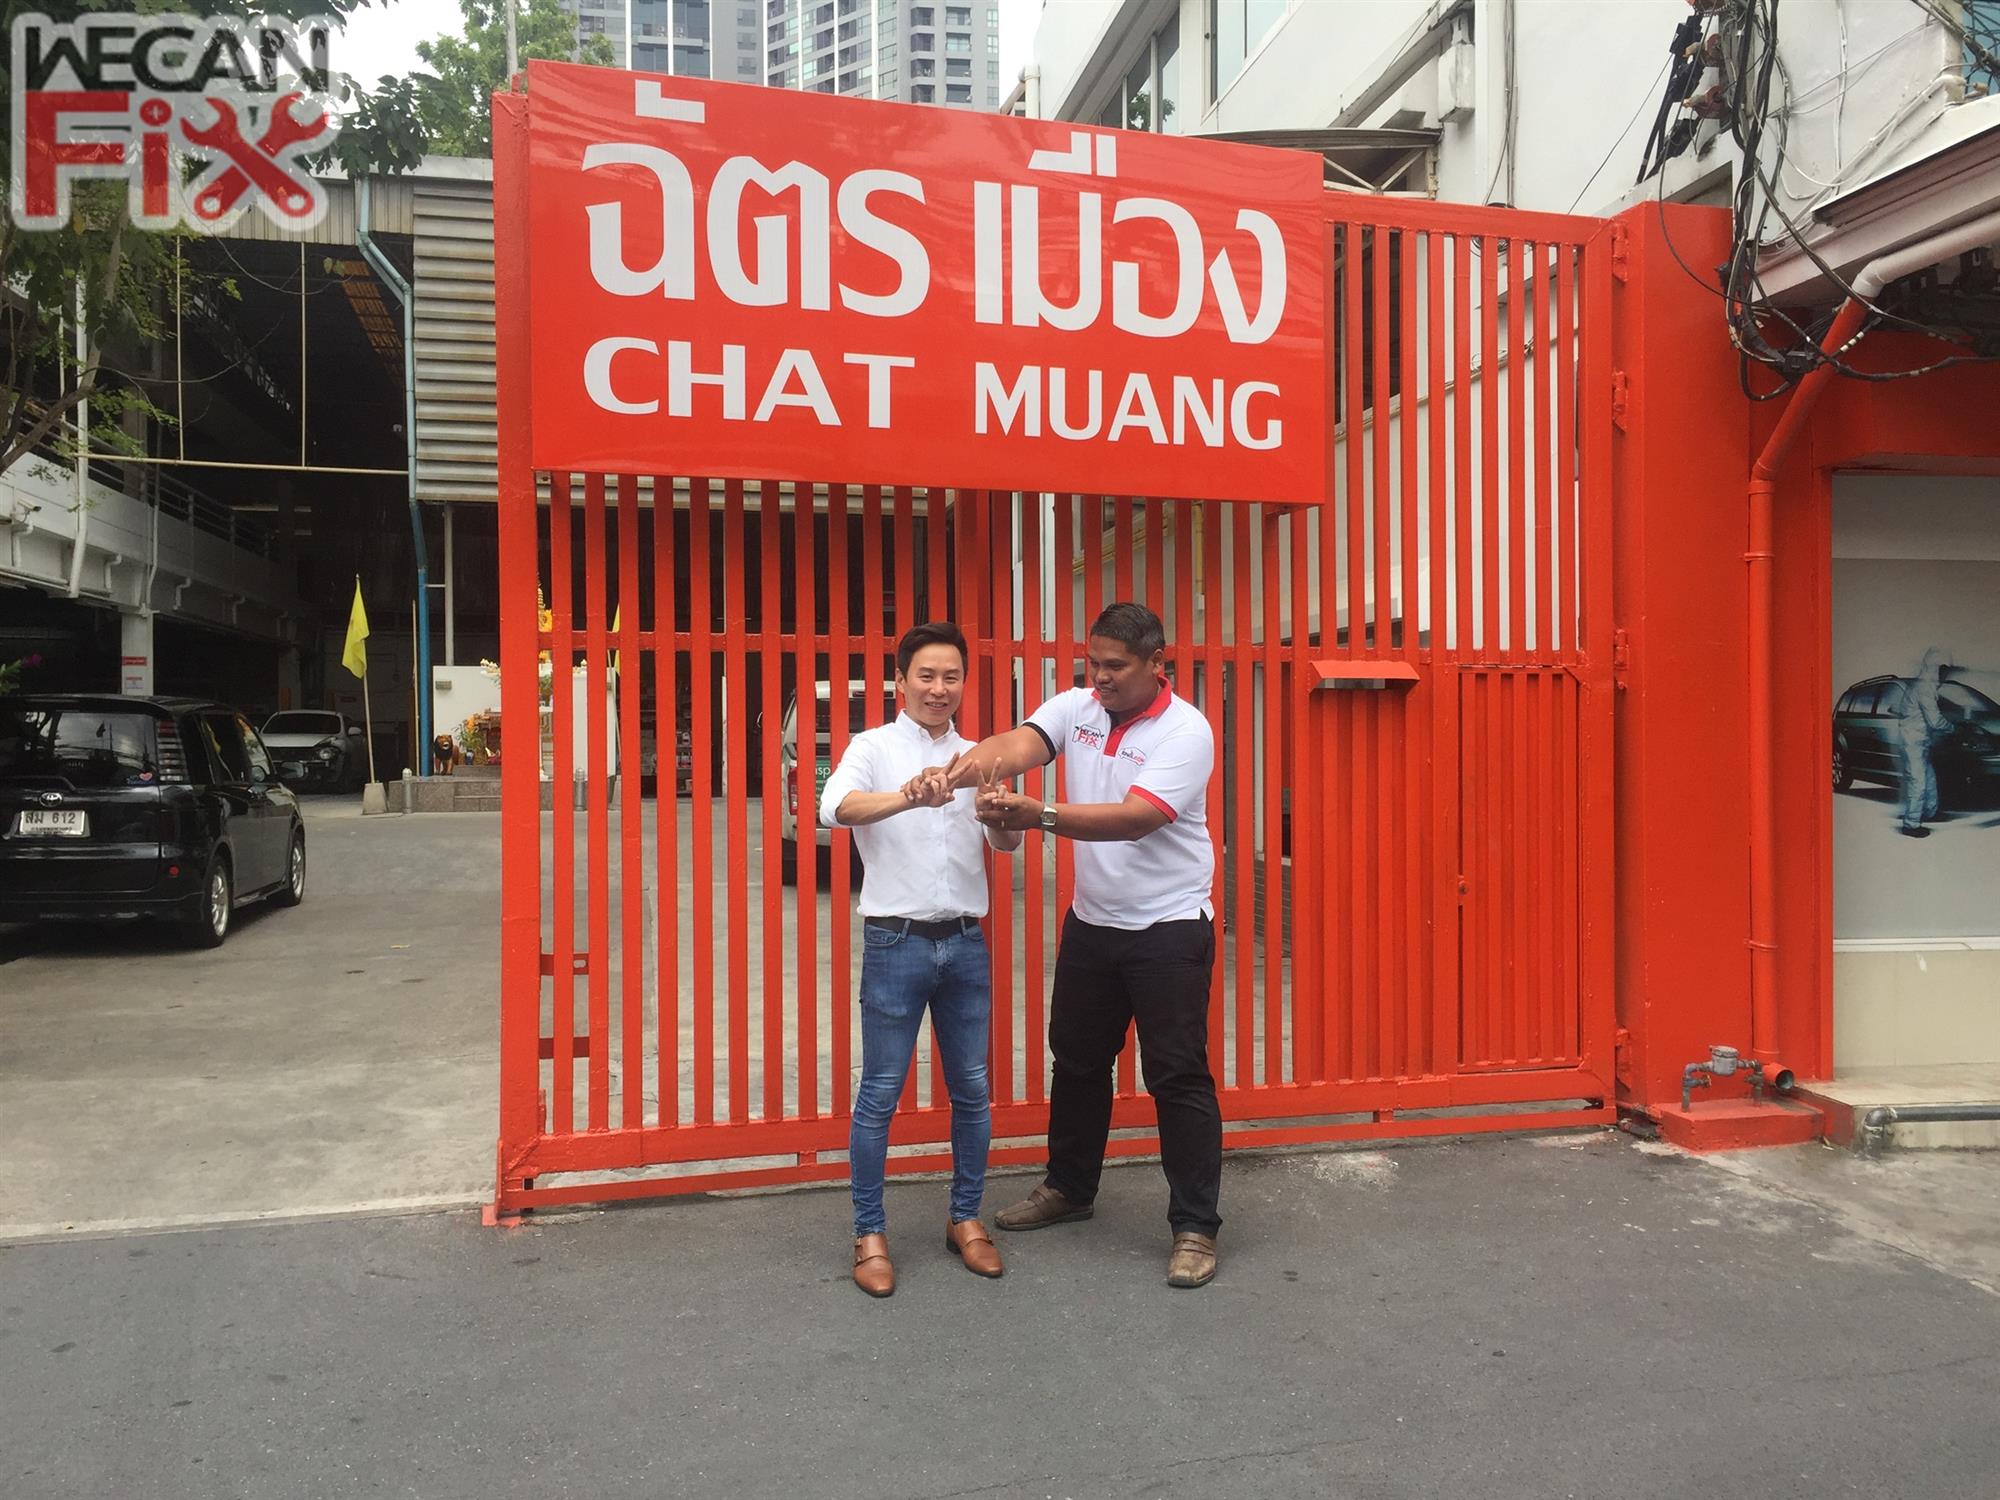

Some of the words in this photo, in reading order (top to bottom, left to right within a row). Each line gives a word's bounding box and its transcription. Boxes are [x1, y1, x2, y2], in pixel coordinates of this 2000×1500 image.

[581, 79, 931, 317] ฉัตร
[974, 131, 1287, 344] เมือง
[583, 337, 915, 429] CHAT
[975, 361, 1282, 450] MUANG
[52, 812, 75, 824] 612
